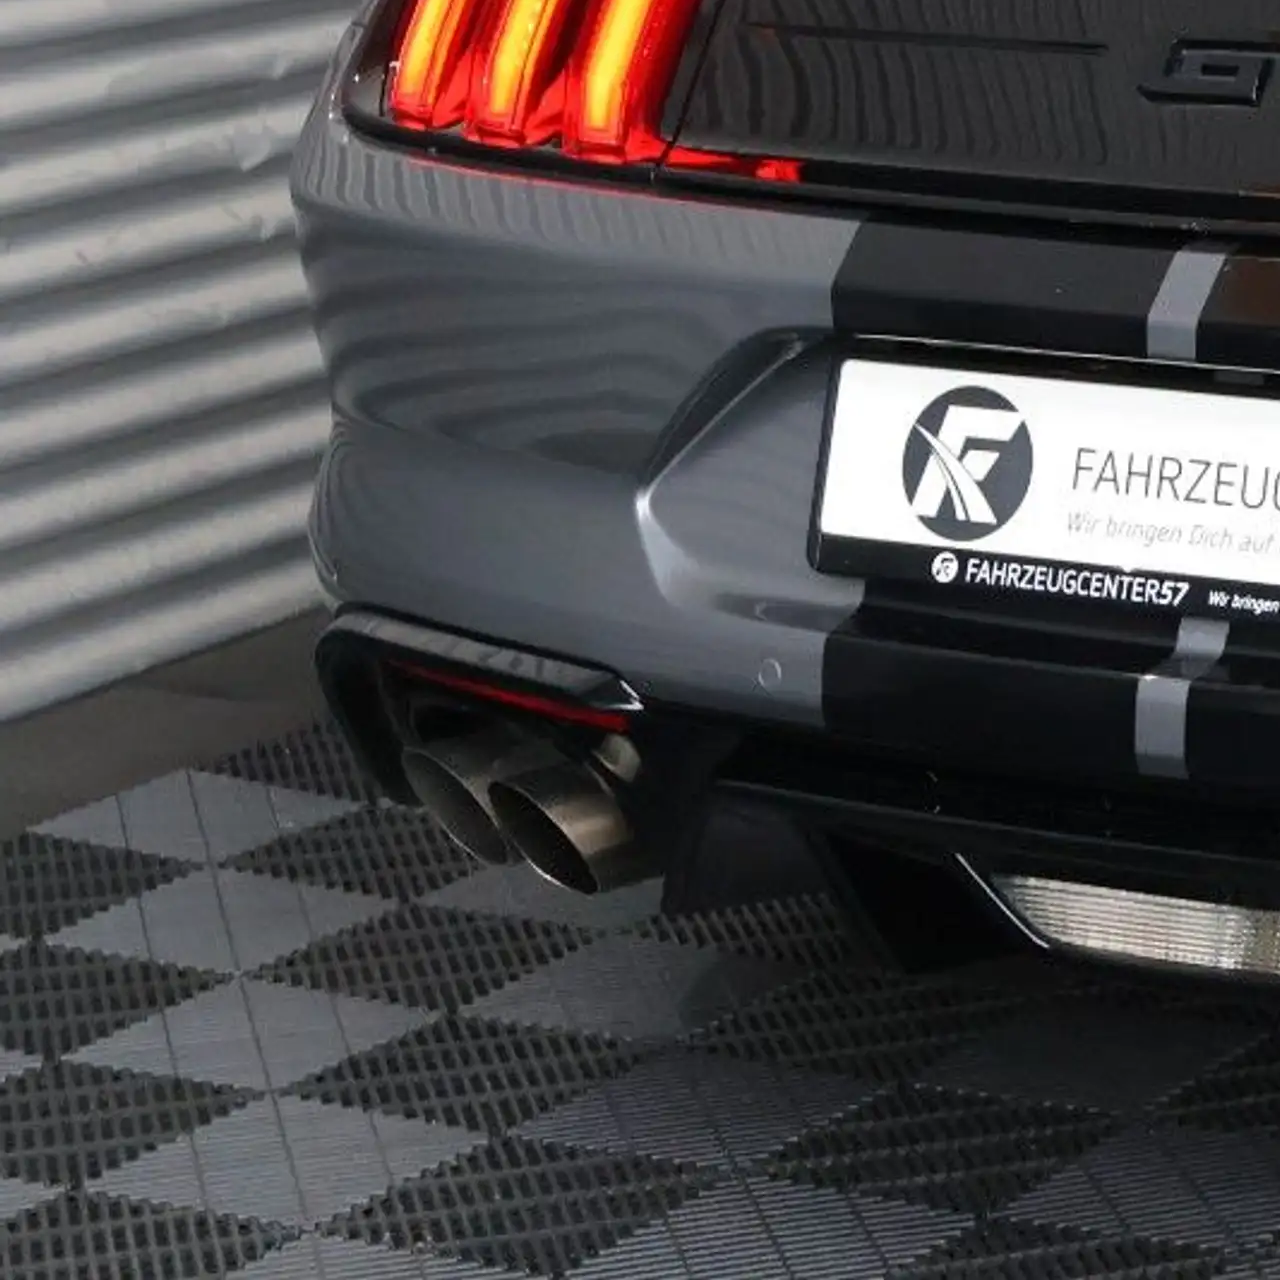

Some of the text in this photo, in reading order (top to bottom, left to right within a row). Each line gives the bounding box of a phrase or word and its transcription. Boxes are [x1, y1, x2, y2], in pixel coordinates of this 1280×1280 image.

[1068, 511, 1100, 535] Wir
[1105, 517, 1183, 547] bringen
[1188, 524, 1233, 550] Dich
[1237, 533, 1275, 555] auf
[964, 558, 1190, 607] FAHRZEUGCENTER57
[1208, 590, 1230, 608] Wir
[1231, 594, 1279, 616] bringen
